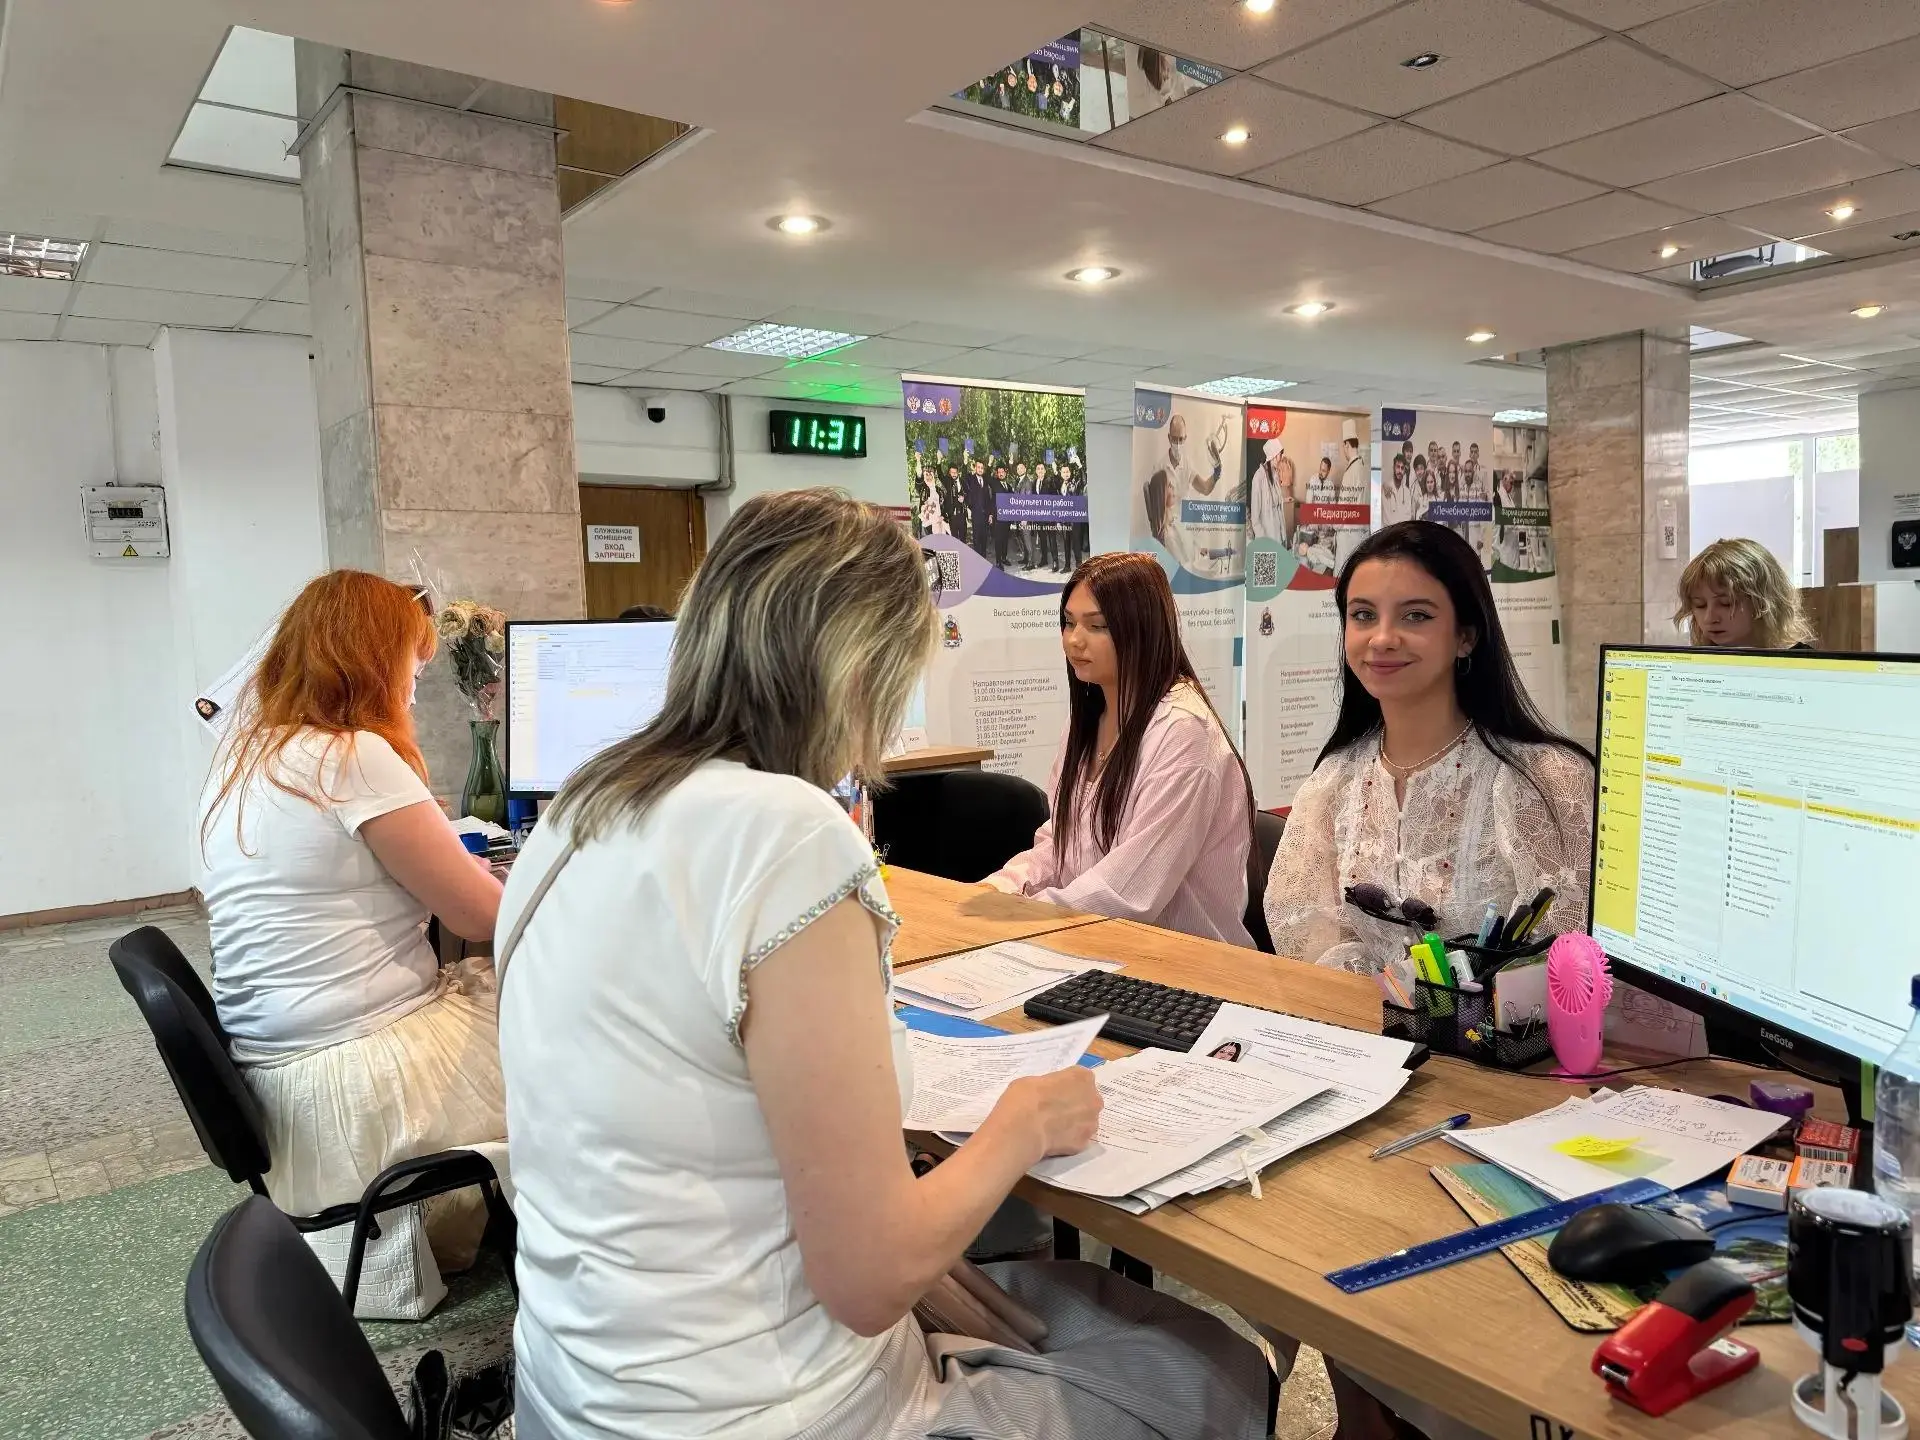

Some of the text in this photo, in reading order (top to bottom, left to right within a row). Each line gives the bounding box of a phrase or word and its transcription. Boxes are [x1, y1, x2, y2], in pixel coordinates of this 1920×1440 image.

[792, 418, 862, 452] 11:31
[1009, 497, 1042, 507] Факультет
[1053, 499, 1074, 507] работе
[1003, 508, 1051, 517] иностранными
[1051, 510, 1088, 519] студентами
[1313, 507, 1361, 521] «Педиатрия»
[594, 527, 633, 535] СЛУЖЕБНОЕ
[604, 543, 625, 552] ВХОД
[594, 551, 636, 560] ЗАПРЕЩЕН
[993, 609, 1020, 617] Высшее
[1021, 608, 1041, 616] благо
[1010, 621, 1044, 631] здоровье
[1760, 1027, 1794, 1049] ExeGate
